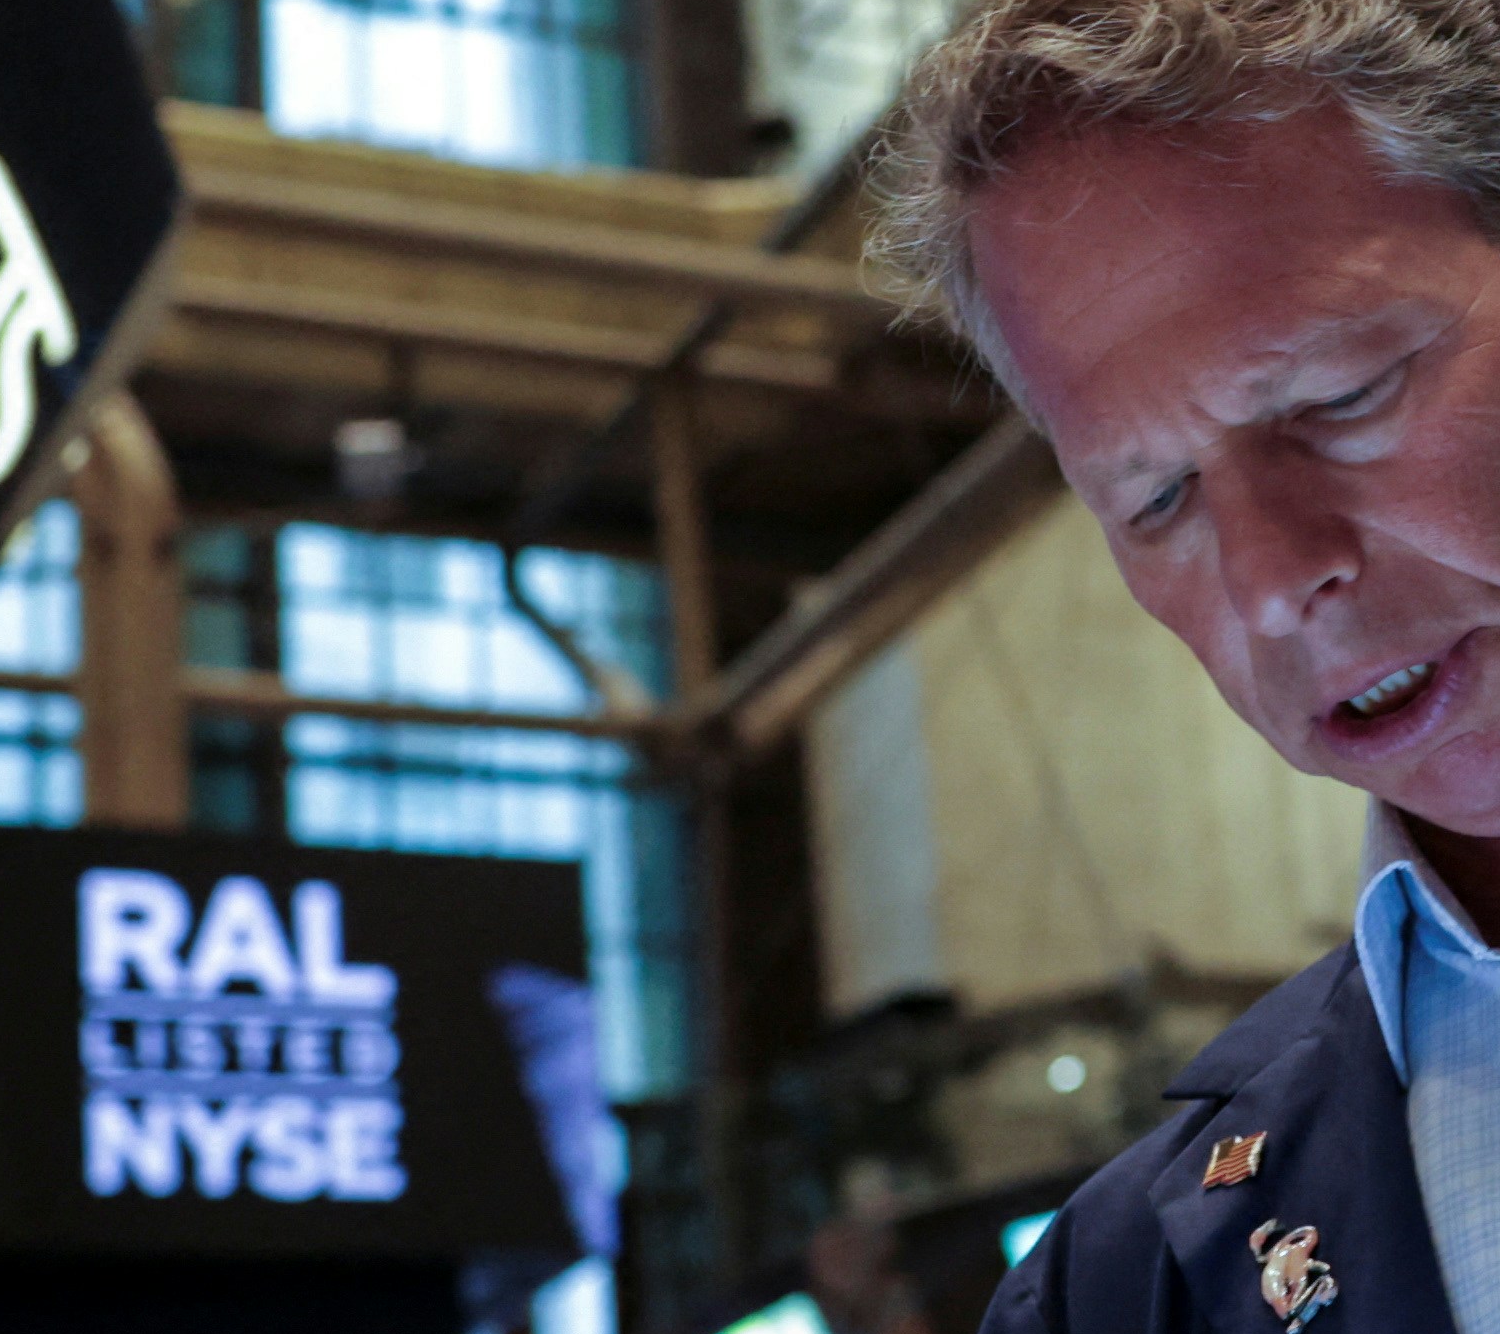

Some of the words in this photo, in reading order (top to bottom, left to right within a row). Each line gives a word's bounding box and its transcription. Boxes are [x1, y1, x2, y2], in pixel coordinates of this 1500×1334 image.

[75, 867, 398, 1010] RAL
[78, 1014, 401, 1087] LISTED
[80, 1088, 409, 1202] NYSE
